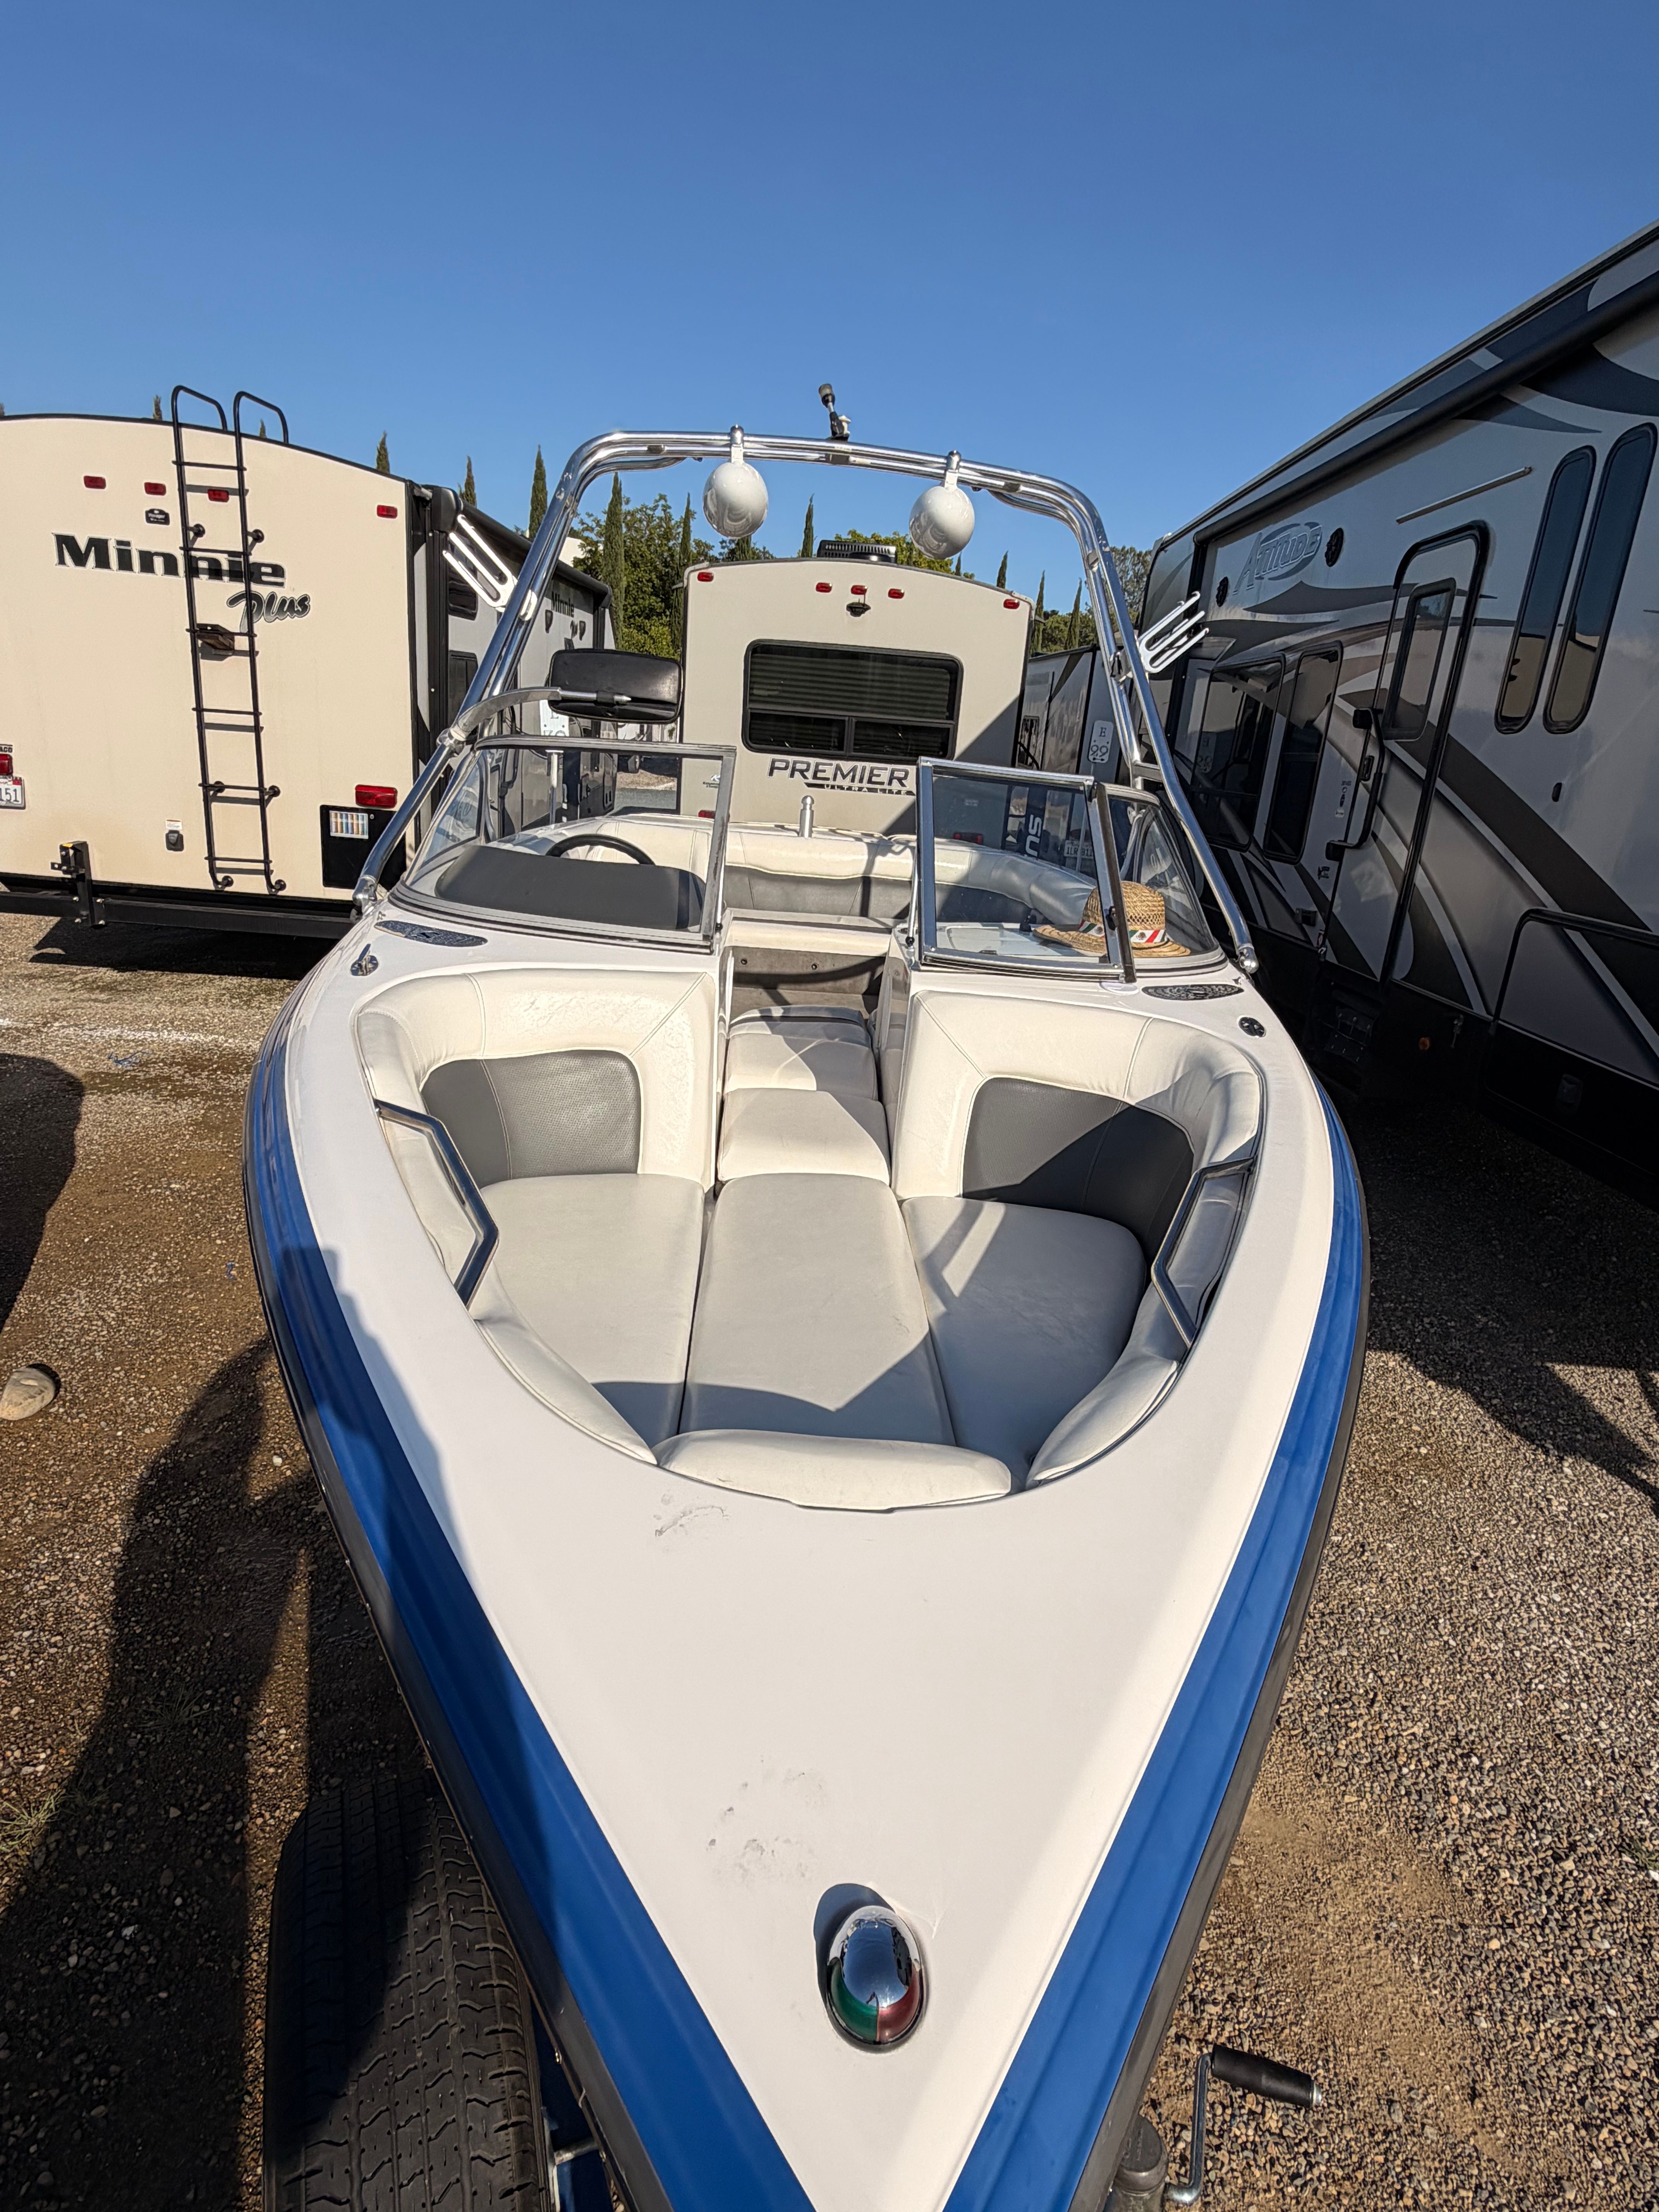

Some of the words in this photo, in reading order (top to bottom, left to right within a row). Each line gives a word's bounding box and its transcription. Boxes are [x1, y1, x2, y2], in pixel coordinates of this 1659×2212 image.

[52, 533, 286, 587] Minnie
[1099, 727, 1107, 737] E
[1090, 744, 1108, 757] 99
[768, 758, 909, 788] PREMIER
[824, 784, 868, 792] ULTRA
